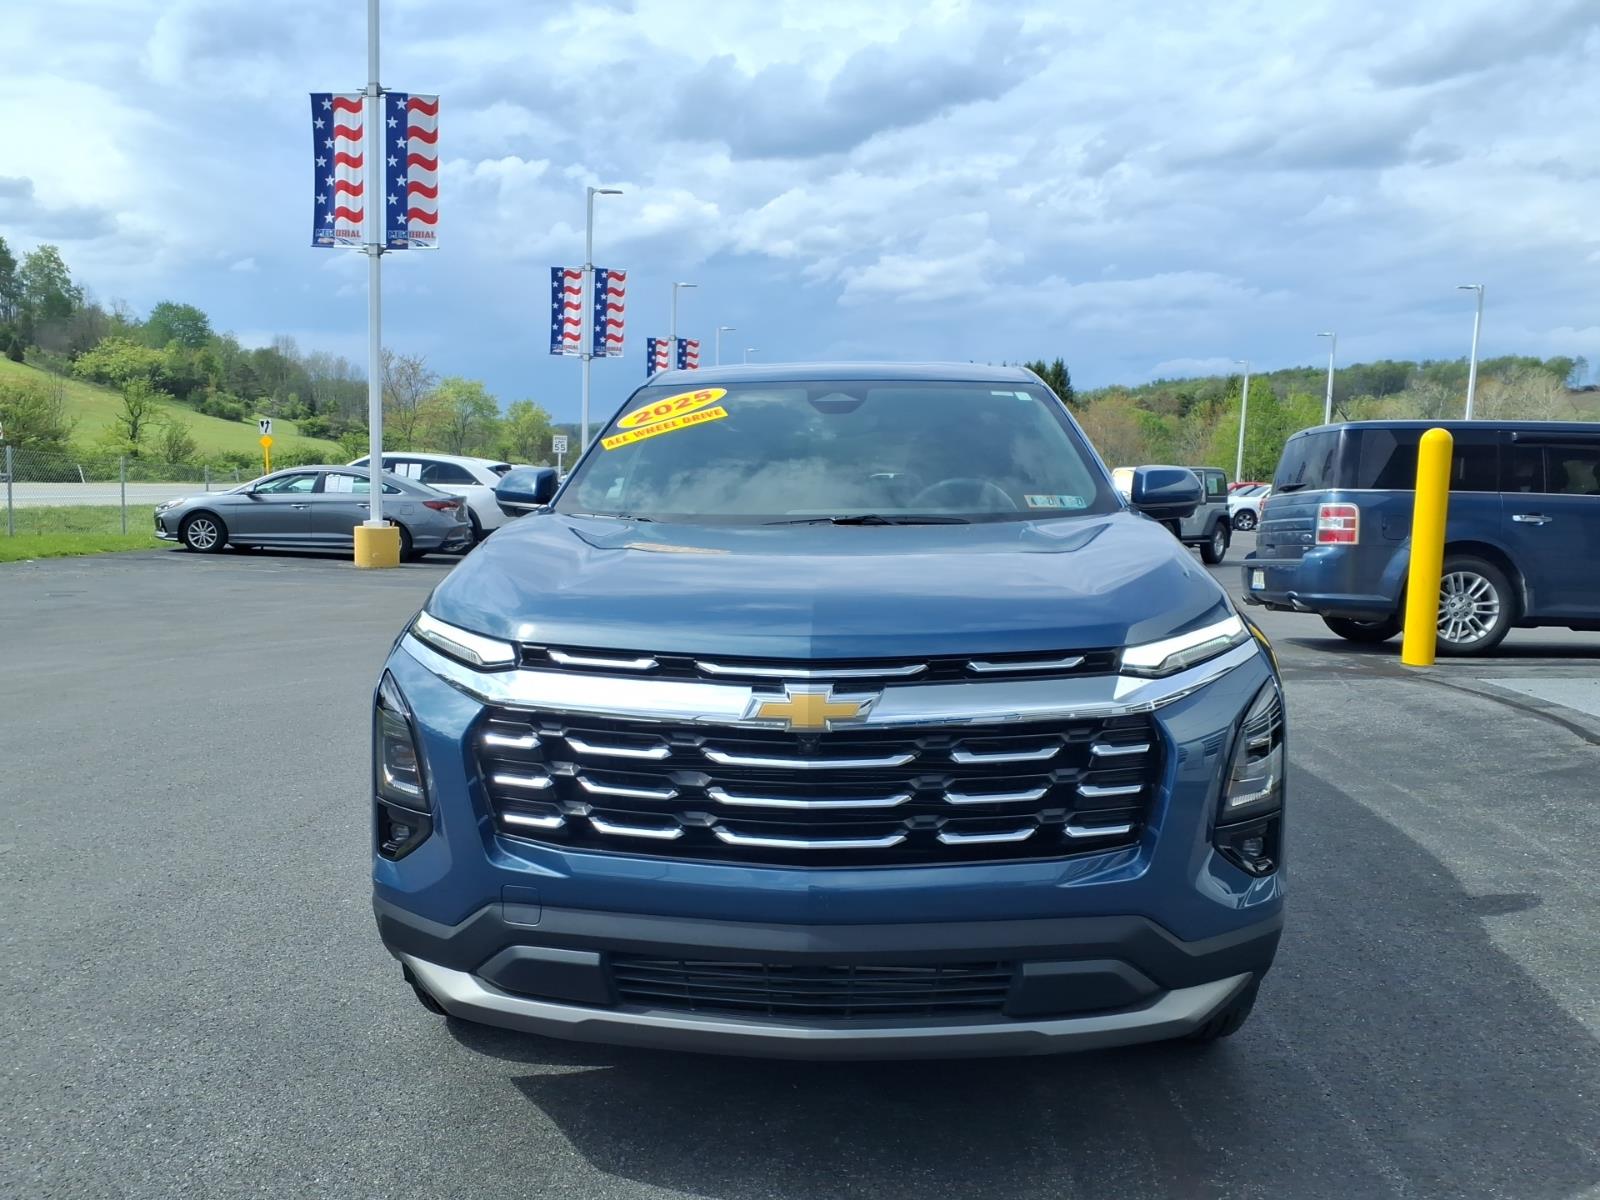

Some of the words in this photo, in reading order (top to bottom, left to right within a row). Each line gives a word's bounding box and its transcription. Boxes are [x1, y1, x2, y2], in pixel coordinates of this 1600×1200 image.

[633, 390, 712, 425] 2025
[606, 435, 630, 447] ALL
[633, 420, 680, 438] WHEEL
[682, 408, 723, 425] DRIVE
[554, 443, 566, 451] 55
